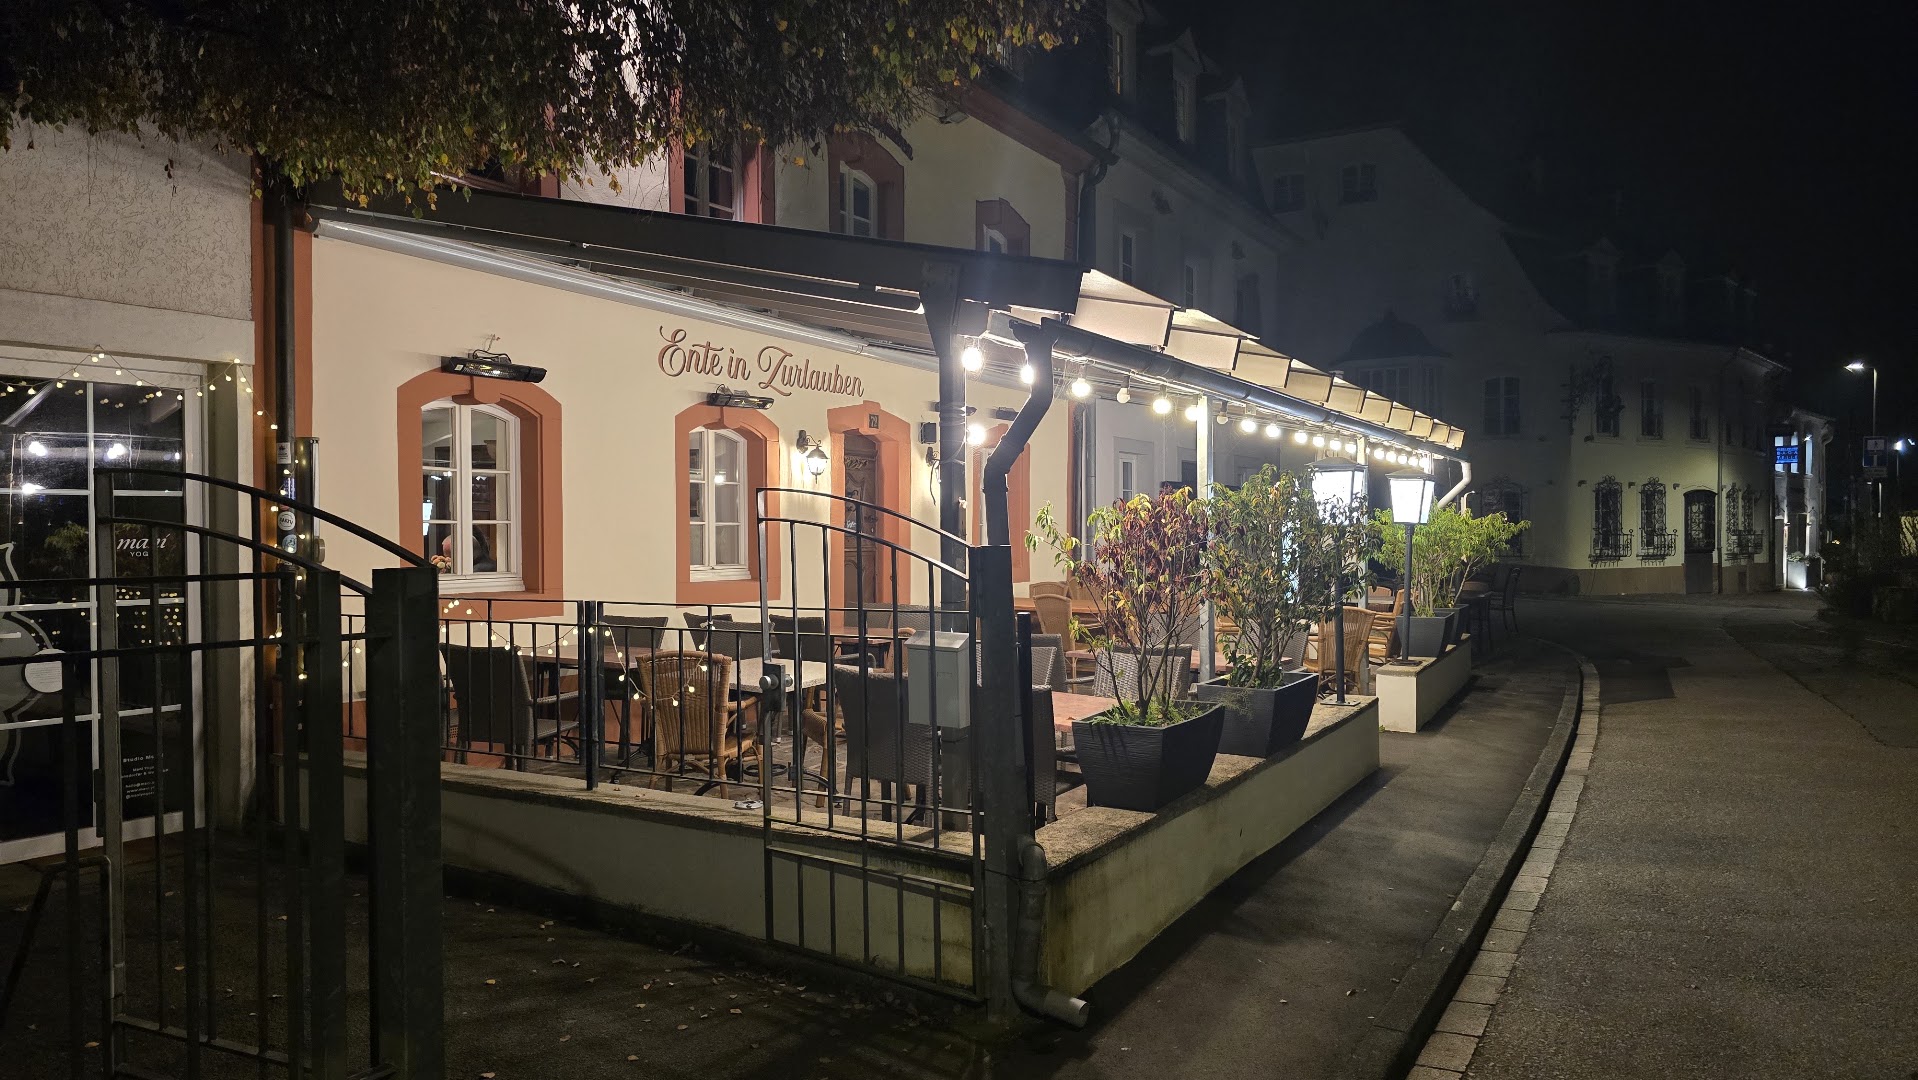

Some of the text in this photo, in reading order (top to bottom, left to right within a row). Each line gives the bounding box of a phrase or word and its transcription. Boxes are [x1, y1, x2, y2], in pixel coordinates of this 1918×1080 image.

[657, 325, 865, 398] Ente in Zurlauben
[870, 415, 878, 428] 72
